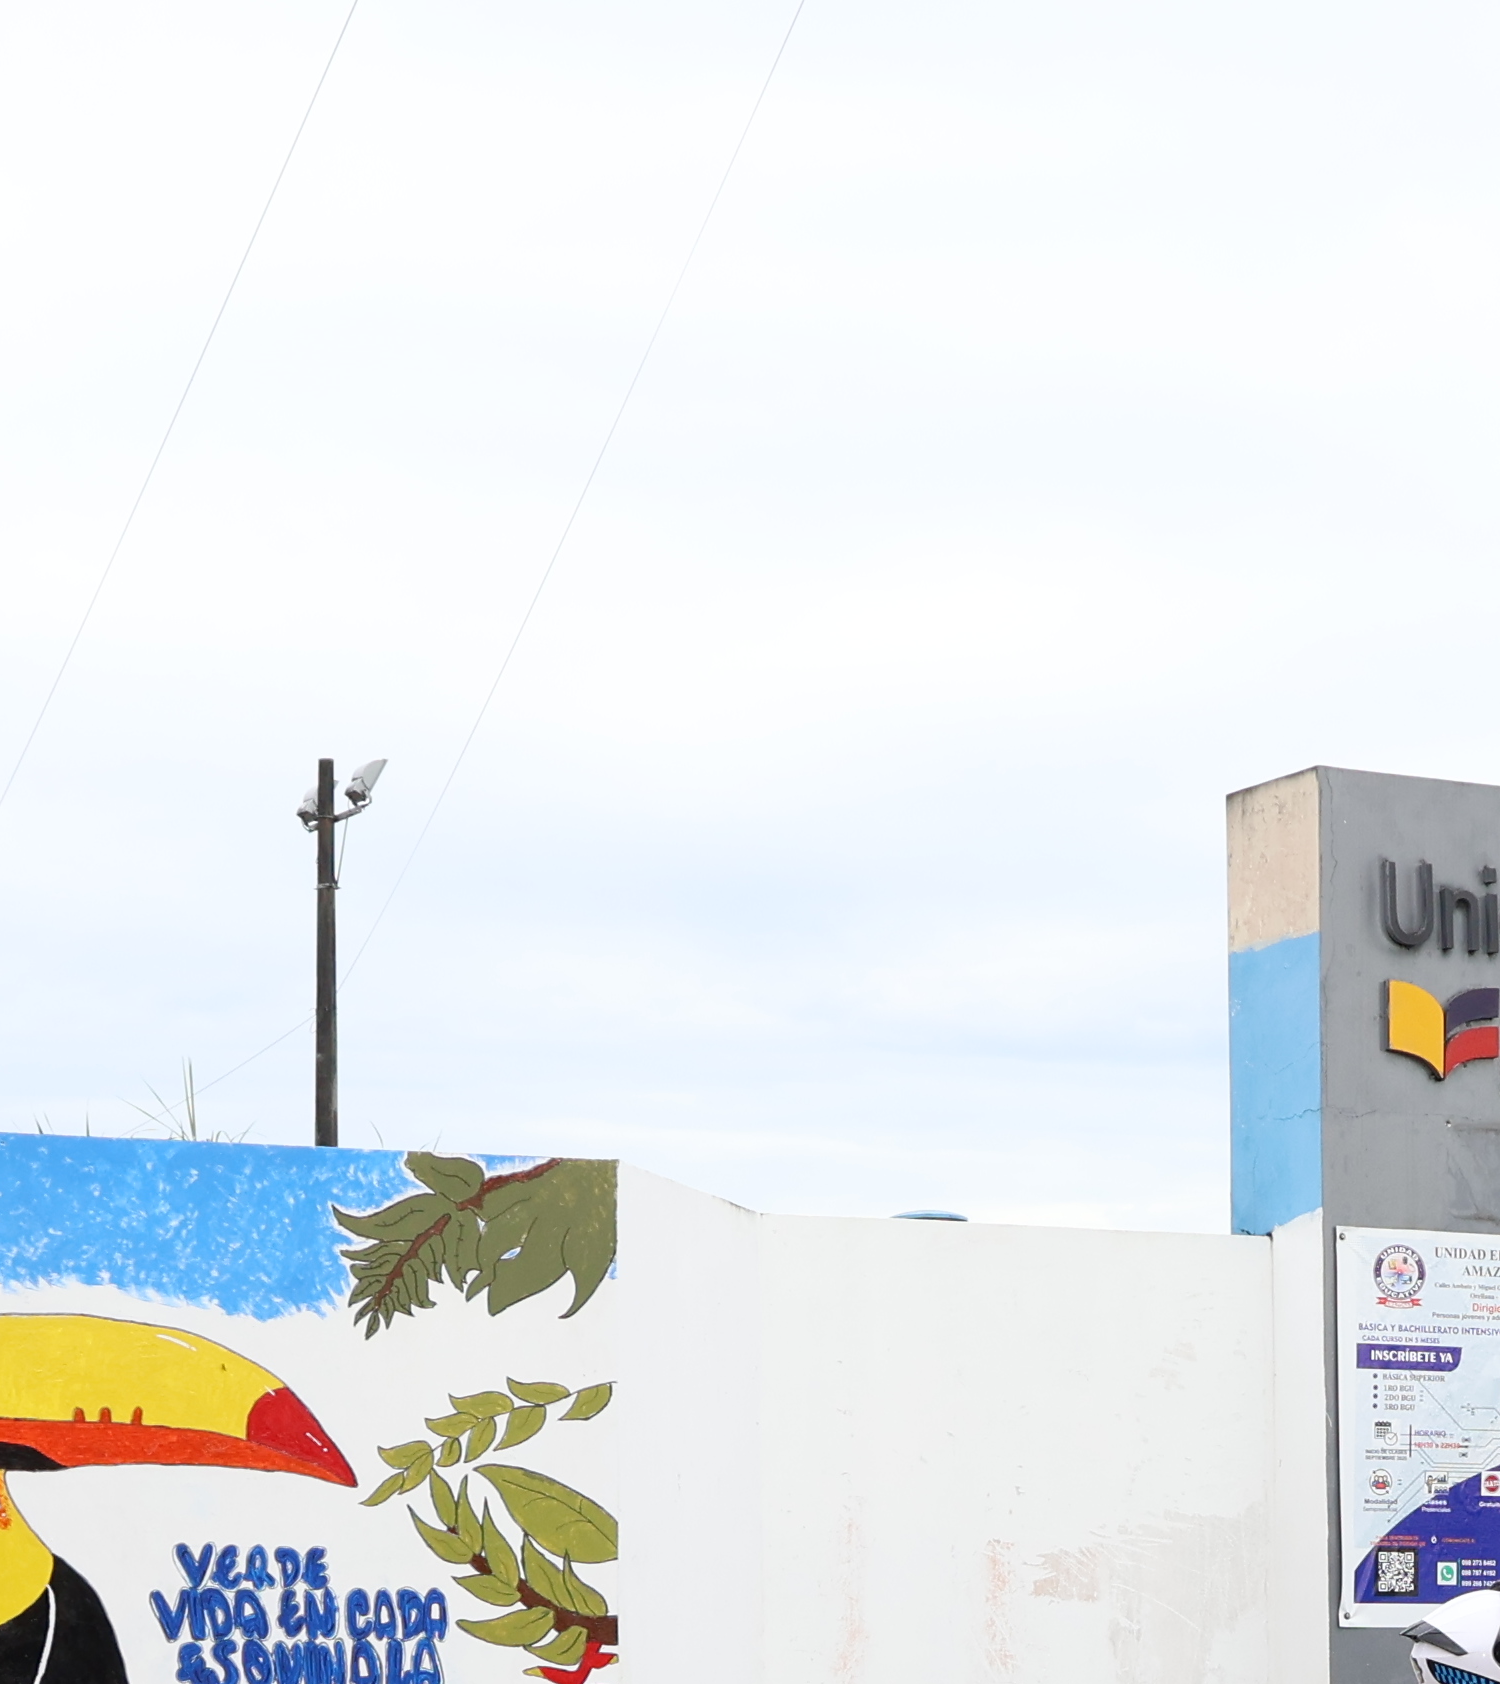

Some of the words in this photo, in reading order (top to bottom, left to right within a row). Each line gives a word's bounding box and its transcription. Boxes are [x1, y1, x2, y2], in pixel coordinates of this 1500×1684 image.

[1380, 1246, 1420, 1261] UNIDAD
[1434, 1246, 1486, 1260] UNIDAD
[1376, 1276, 1423, 1298] EDUCATIVA
[1432, 1311, 1460, 1319] Personas
[1358, 1321, 1388, 1332] BÁSICA
[1391, 1324, 1397, 1332] Y
[1398, 1324, 1459, 1335] BACHILLERATO
[1370, 1348, 1437, 1363] INSCRÍBETE
[1439, 1352, 1453, 1363] YA
[1382, 1371, 1408, 1381] BÁSICA
[1409, 1374, 1446, 1382] SUPERIOR
[173, 1542, 330, 1590] VERDE
[150, 1586, 272, 1642] VIDA
[276, 1586, 340, 1640] EN
[346, 1586, 449, 1642] CADA
